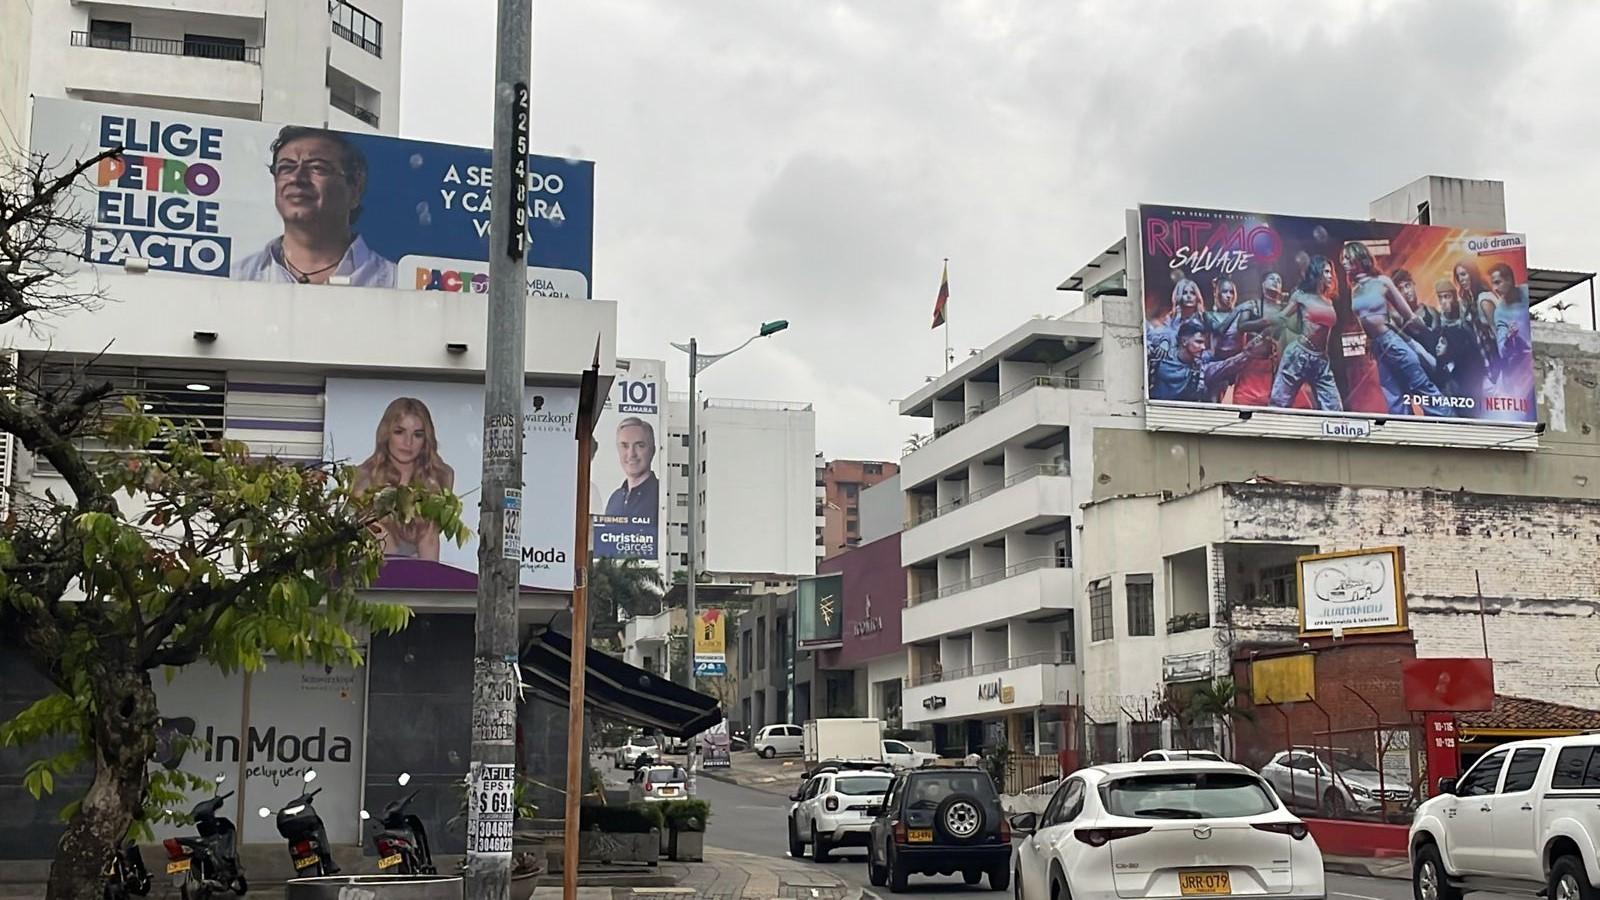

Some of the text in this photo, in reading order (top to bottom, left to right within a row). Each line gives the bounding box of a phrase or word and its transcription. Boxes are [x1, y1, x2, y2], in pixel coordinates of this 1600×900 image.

[100, 115, 223, 161] ELIGE
[97, 154, 221, 197] PETRO
[443, 164, 564, 194] A SEDO
[98, 190, 220, 234] ELIGE
[440, 189, 566, 221] Y CÁRA
[90, 231, 226, 272] PACTO
[1147, 218, 1284, 265] RITMO
[1467, 238, 1489, 251] Qué
[1168, 245, 1255, 274] SALVAJE
[618, 380, 656, 405] 101
[1403, 394, 1411, 405] 2
[1413, 395, 1429, 406] DE
[1432, 396, 1475, 408] MARZO
[523, 411, 574, 426] warzkopf
[1326, 423, 1364, 436] Latina
[600, 533, 654, 543] Christian
[521, 546, 565, 562] Moda
[483, 781, 504, 791] EPS
